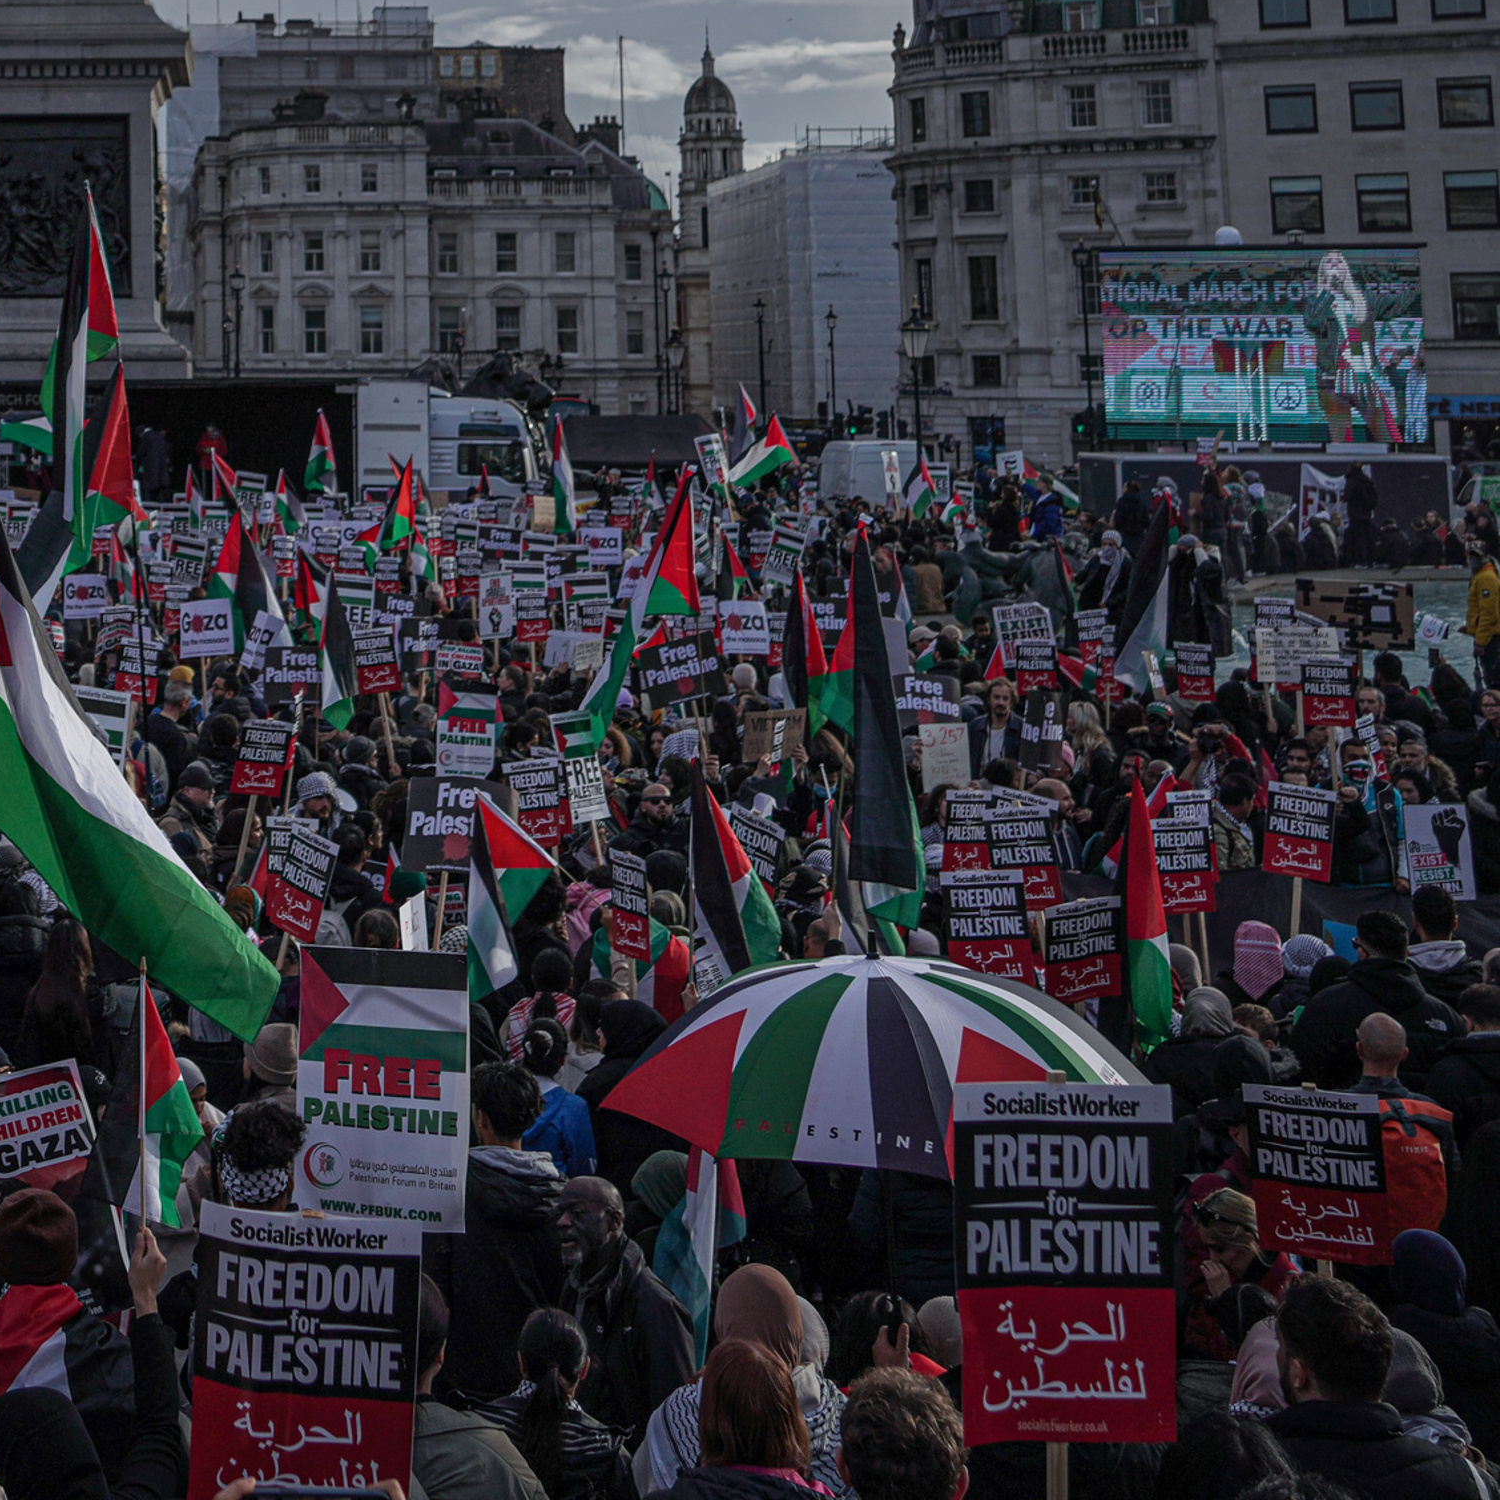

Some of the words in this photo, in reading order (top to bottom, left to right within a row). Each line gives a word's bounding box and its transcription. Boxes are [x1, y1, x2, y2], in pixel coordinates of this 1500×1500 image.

[1190, 281, 1267, 302] MARCH
[1221, 318, 1293, 339] WAR
[354, 637, 392, 652] FREEDOM
[659, 642, 697, 665] Free
[281, 651, 318, 668] Free
[646, 655, 719, 687] Palestine
[1305, 666, 1349, 680] FREEDOM
[1304, 681, 1352, 696] PALESTINE
[245, 729, 287, 745] FREEDOM
[239, 747, 285, 764] PALESTINE
[509, 771, 556, 790] FREEDOM
[566, 756, 601, 788] FREE
[1273, 794, 1329, 818] FREEDOM
[732, 819, 779, 858] FREEDOM
[947, 825, 987, 841] PALESTINE
[990, 820, 1047, 841] FREEDOM
[1154, 830, 1205, 848] FREEDOM
[1269, 815, 1330, 840] PALESTINE
[290, 839, 330, 873] FREEDOM
[992, 844, 1054, 866] PALESTINE
[1156, 852, 1209, 871] PALESTINE
[1411, 853, 1448, 868] EXIST.
[283, 861, 327, 899] PALESTINE
[950, 887, 1017, 909] FREEDOM
[950, 915, 1026, 938] PALESTINE
[1051, 911, 1113, 938] FREEDOM
[964, 943, 1014, 965] الحرية
[1050, 933, 1117, 962] PALESTINE
[324, 1047, 442, 1100] FREE
[304, 1097, 458, 1137] PALESTINE
[1258, 1108, 1368, 1146] FREEDOM
[1305, 1141, 1325, 1155] for
[973, 1133, 1151, 1190] FREEDOM
[1257, 1147, 1378, 1187] PALESTINE
[349, 1171, 390, 1185] Palestinian
[392, 1176, 417, 1188] Forum
[419, 1179, 426, 1189] in
[428, 1180, 457, 1192] Britain
[320, 1199, 442, 1223] WWW.PFBUK.COM
[1046, 1189, 1078, 1217] for
[1281, 1189, 1360, 1220] الحرية
[1274, 1218, 1375, 1246] لفلسطين
[966, 1218, 1162, 1276] PALESTINE
[216, 1250, 396, 1315] FREEDOM
[290, 1309, 320, 1335] for
[996, 1300, 1126, 1356] الحرية
[205, 1321, 403, 1391] PALESTINE
[983, 1355, 1147, 1413] لفلسطين
[233, 1400, 362, 1451] الحرية
[1017, 1417, 1109, 1434] socialistworker.co.uk
